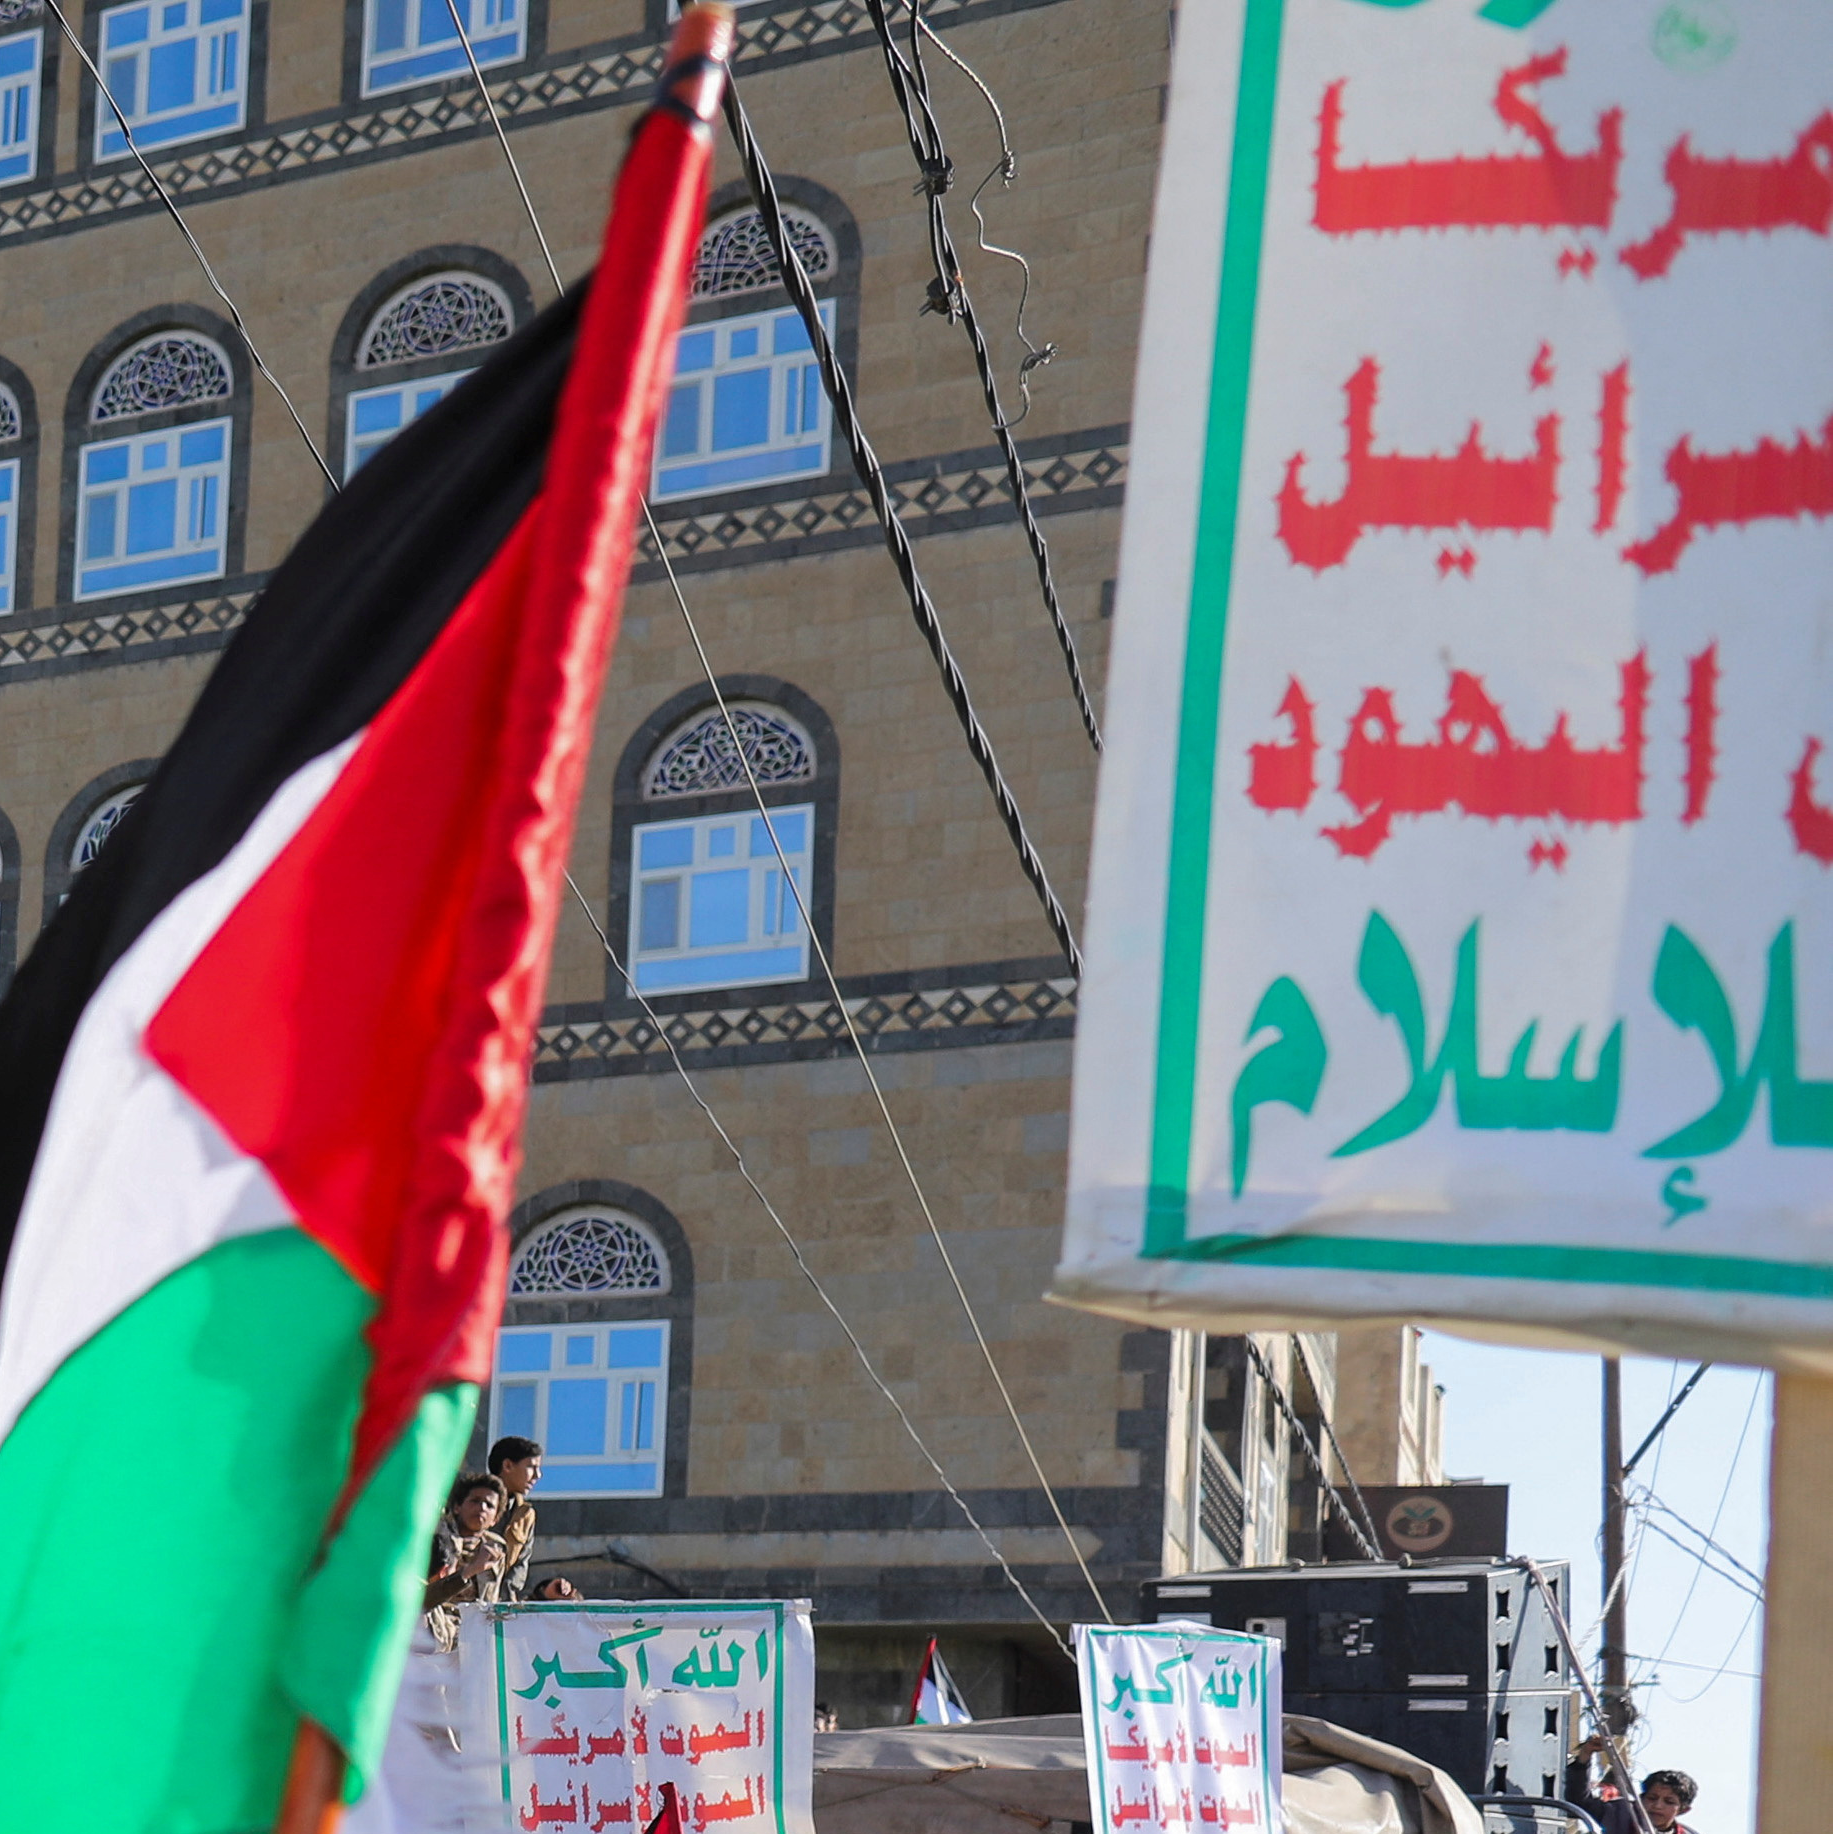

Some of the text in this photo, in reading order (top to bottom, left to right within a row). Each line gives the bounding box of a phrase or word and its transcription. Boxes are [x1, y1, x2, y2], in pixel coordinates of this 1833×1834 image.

[1244, 640, 1724, 872] اليهود
[1229, 906, 1833, 1228] لإسلام
[512, 1618, 768, 1709] الله أكبر
[1200, 1655, 1257, 1709] الله
[515, 1705, 765, 1766] الموت لأمريكا
[1104, 1720, 1257, 1773] الموت لأمريكا
[1199, 1790, 1261, 1832] الموت
